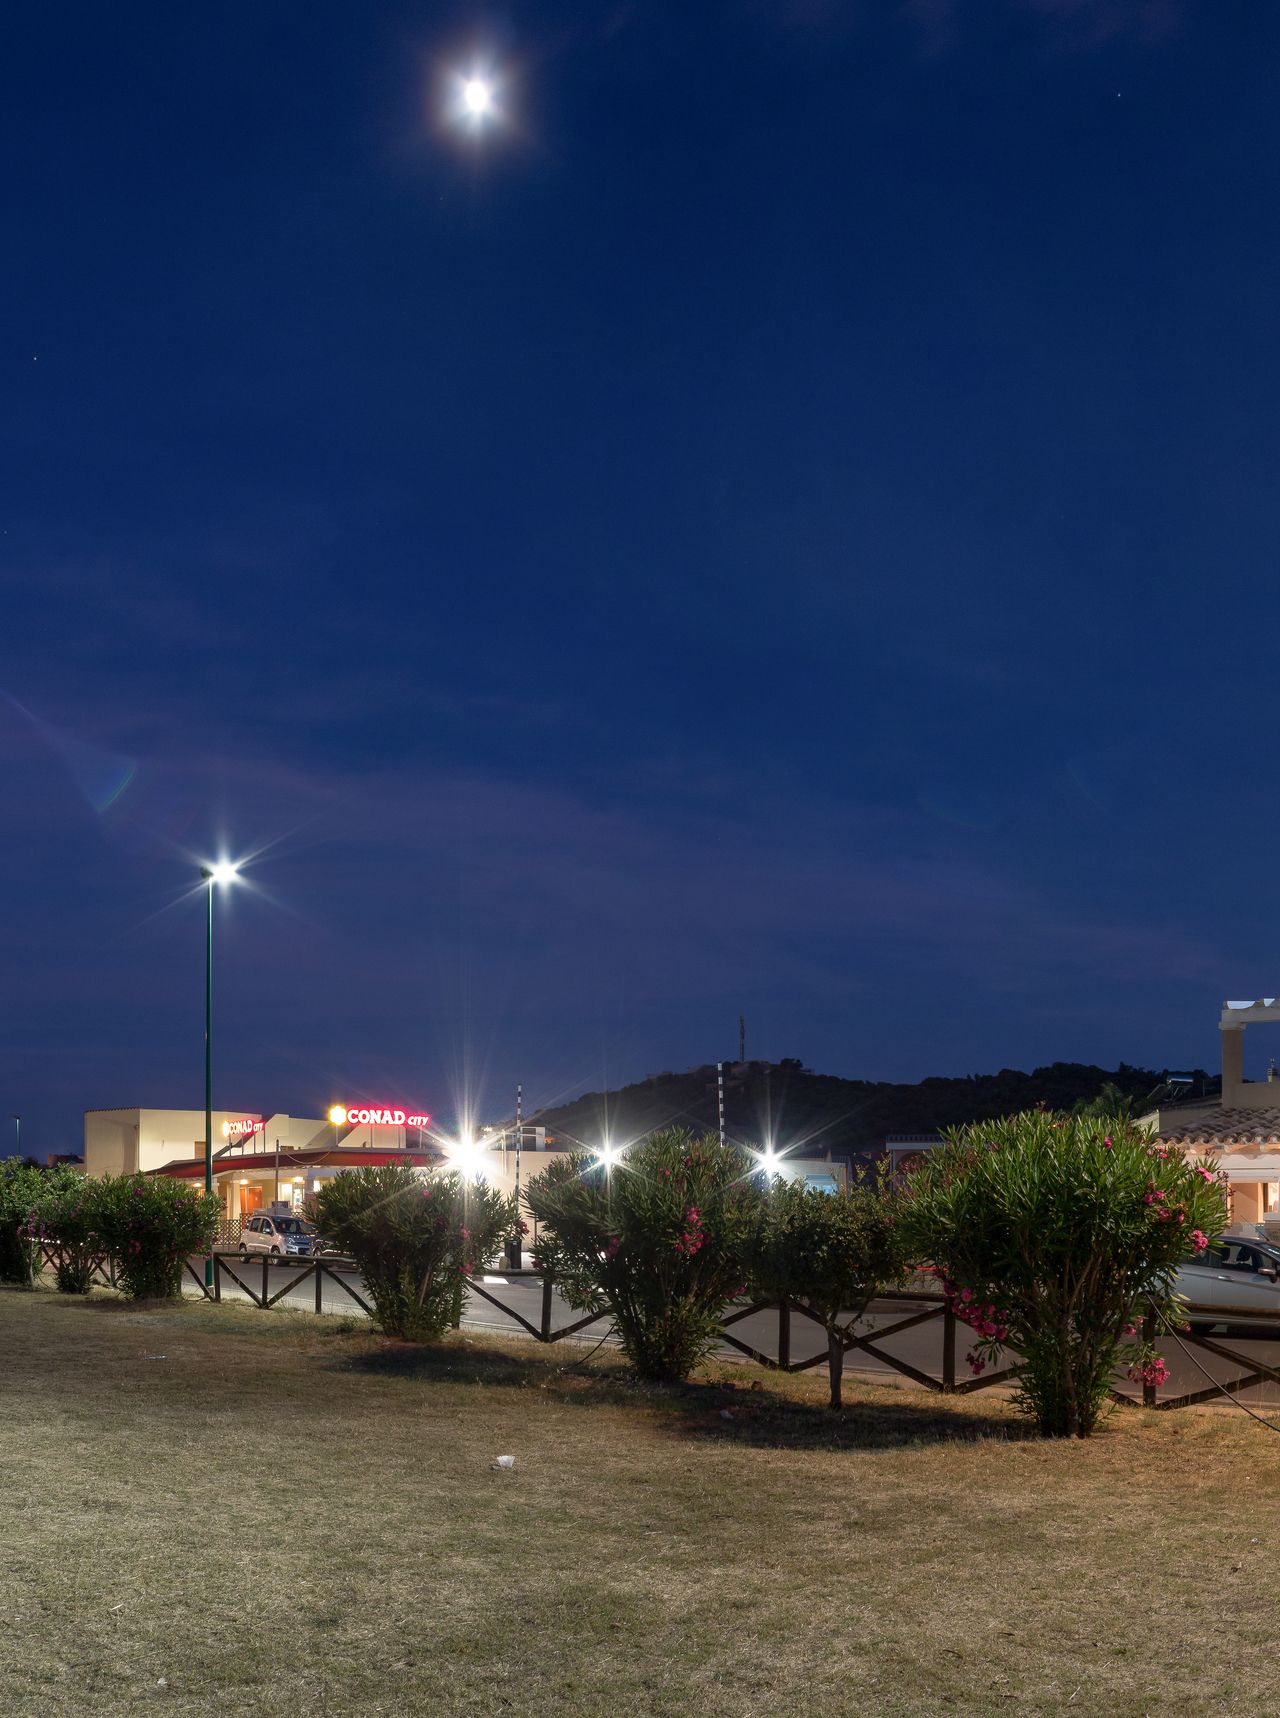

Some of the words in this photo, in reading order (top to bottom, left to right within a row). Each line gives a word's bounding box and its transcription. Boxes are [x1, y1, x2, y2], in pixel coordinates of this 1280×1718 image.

[347, 1109, 406, 1125] CONAD
[407, 1115, 429, 1126] CITY
[229, 1120, 253, 1135] CONAD
